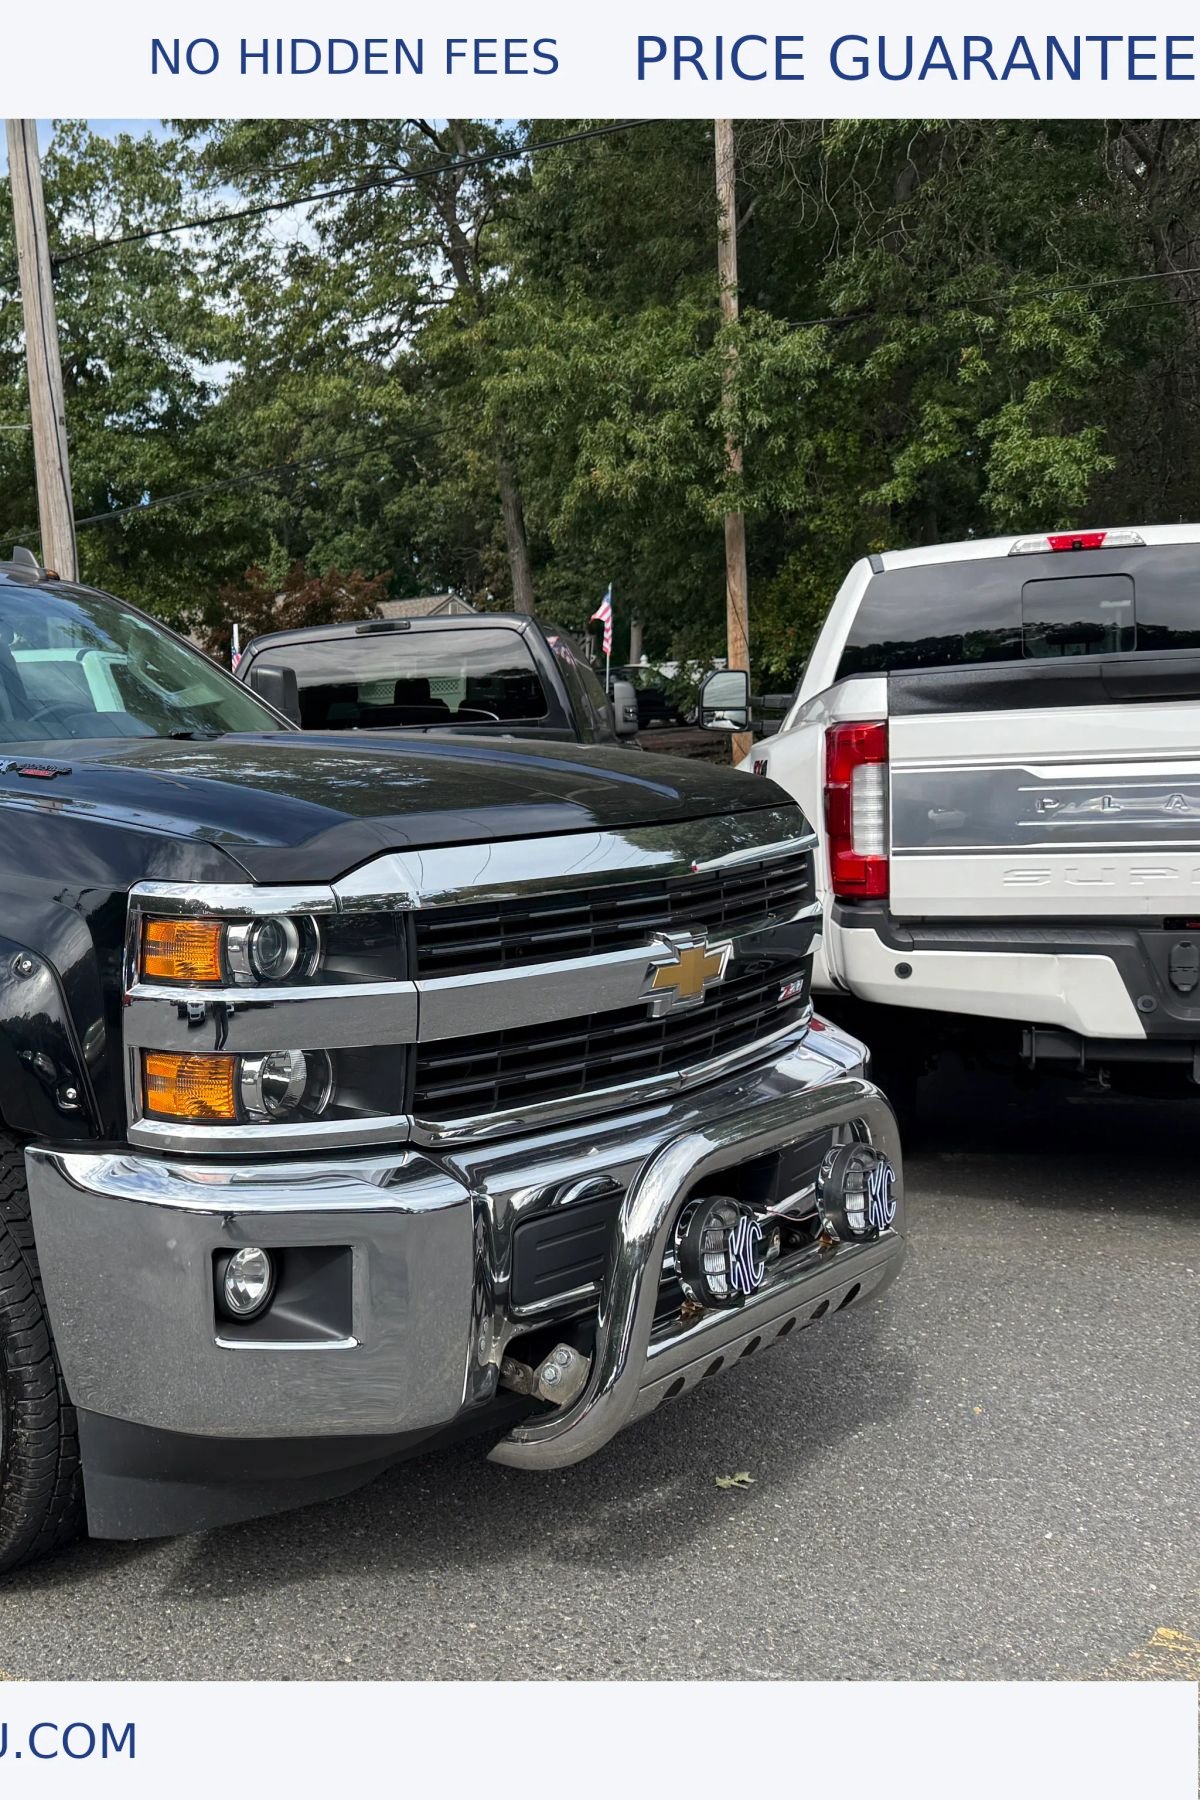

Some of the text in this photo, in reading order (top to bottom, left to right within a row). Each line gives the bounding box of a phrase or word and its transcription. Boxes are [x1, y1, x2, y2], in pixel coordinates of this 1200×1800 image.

[1003, 868, 1200, 887] SUP
[867, 1161, 897, 1231] KC
[727, 1215, 766, 1295] KC
